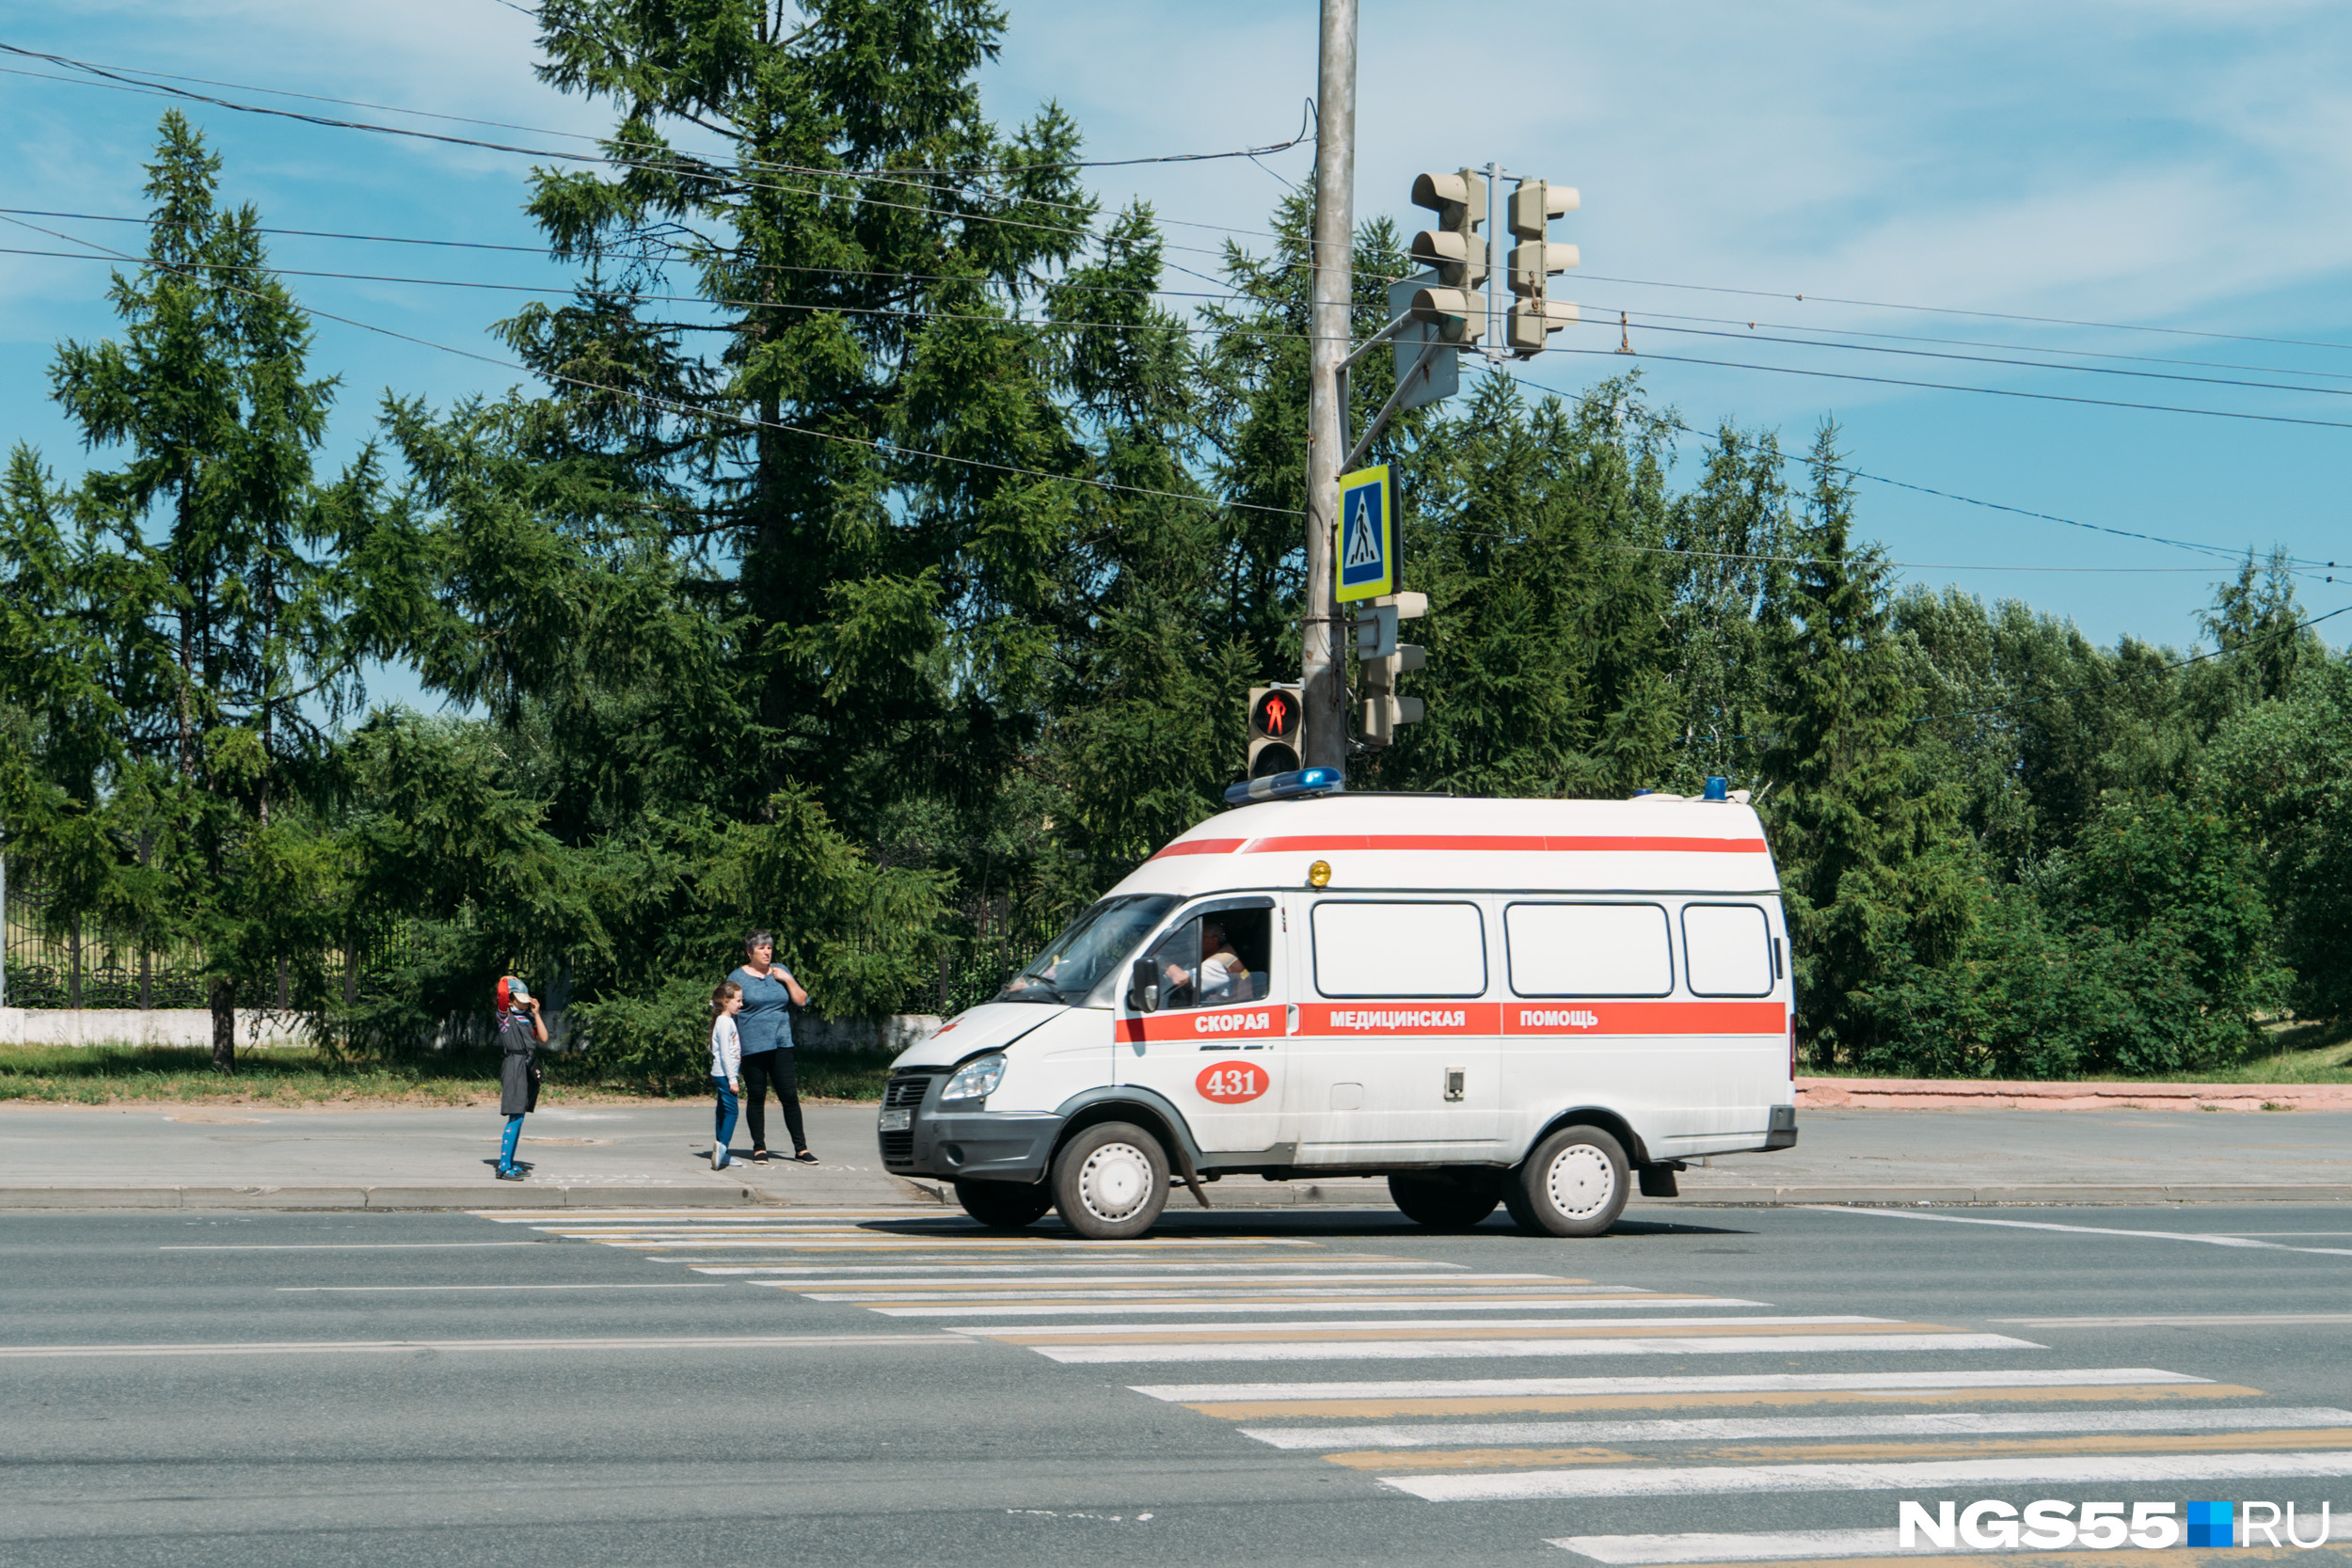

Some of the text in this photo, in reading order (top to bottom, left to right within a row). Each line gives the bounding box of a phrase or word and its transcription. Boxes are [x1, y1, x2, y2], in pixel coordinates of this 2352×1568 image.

[1195, 1010, 1598, 1033] СКОРАЯ МЕДИЦИНСКАЯ ПОМОЩЬ
[1206, 1069, 1257, 1096] 431
